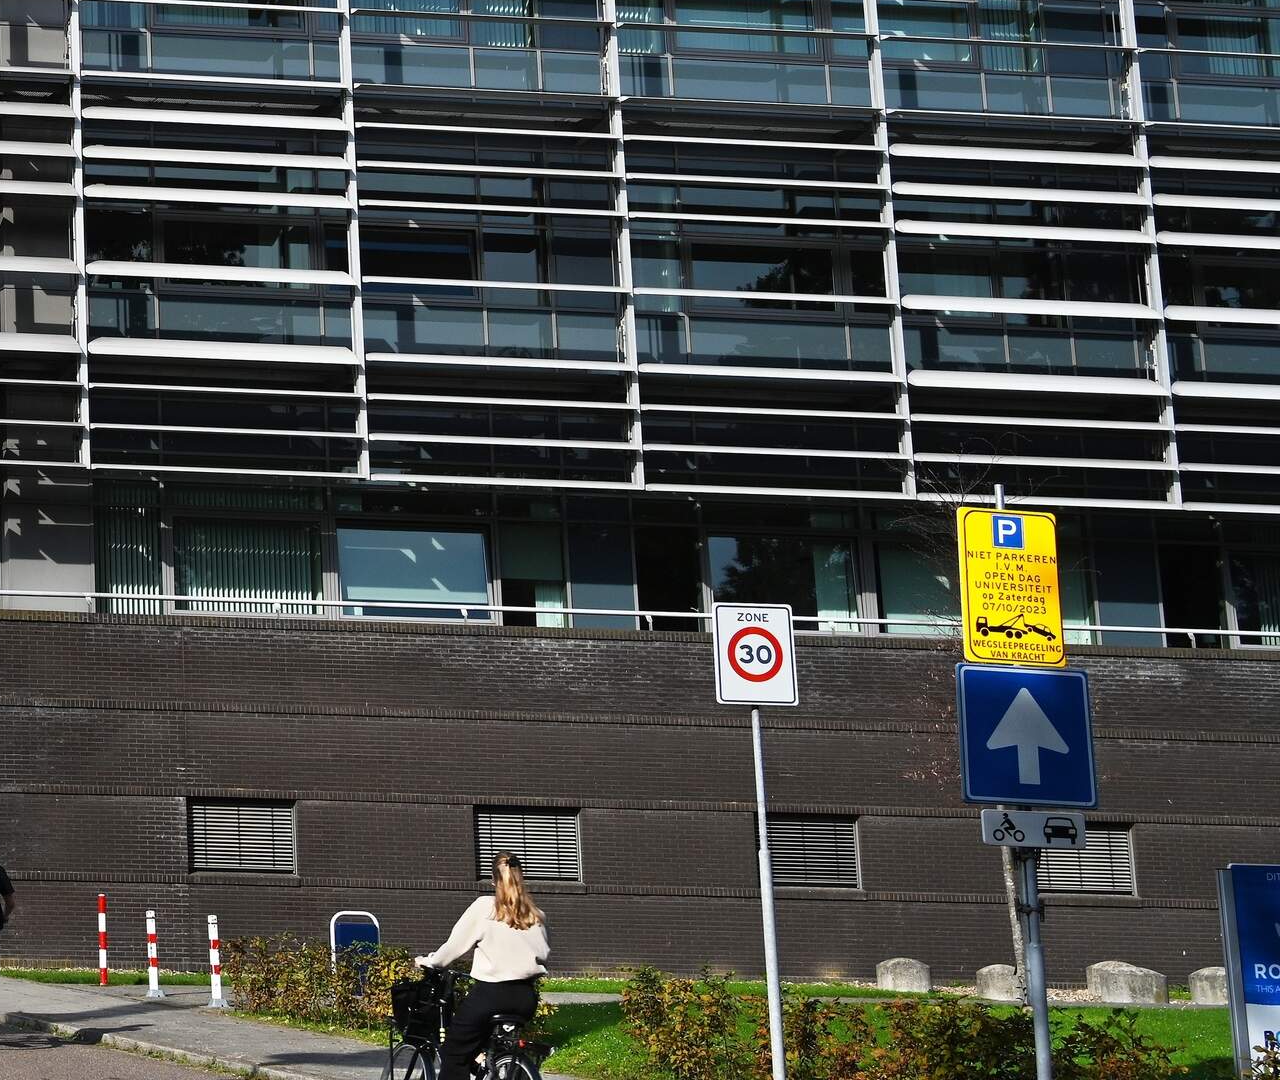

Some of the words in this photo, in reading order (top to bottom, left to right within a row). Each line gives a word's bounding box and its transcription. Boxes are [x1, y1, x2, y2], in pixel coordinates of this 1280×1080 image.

[998, 520, 1017, 544] P
[967, 550, 991, 560] NIET
[995, 552, 1056, 564] PARKEREN
[984, 571, 1014, 581] OPEN
[1019, 573, 1041, 582] DAG
[975, 581, 1052, 593] UNIVERSITEIT
[982, 593, 994, 601] op
[998, 592, 1046, 605] Zaterdag
[982, 603, 1047, 615] 07/10/2023
[737, 612, 769, 623] ZONE
[973, 639, 1062, 653] WEGSLEEPREGELING
[739, 644, 772, 665] 30
[990, 650, 1009, 659] VAN
[1012, 651, 1046, 661] KRACHT
[1256, 984, 1274, 993] THIS
